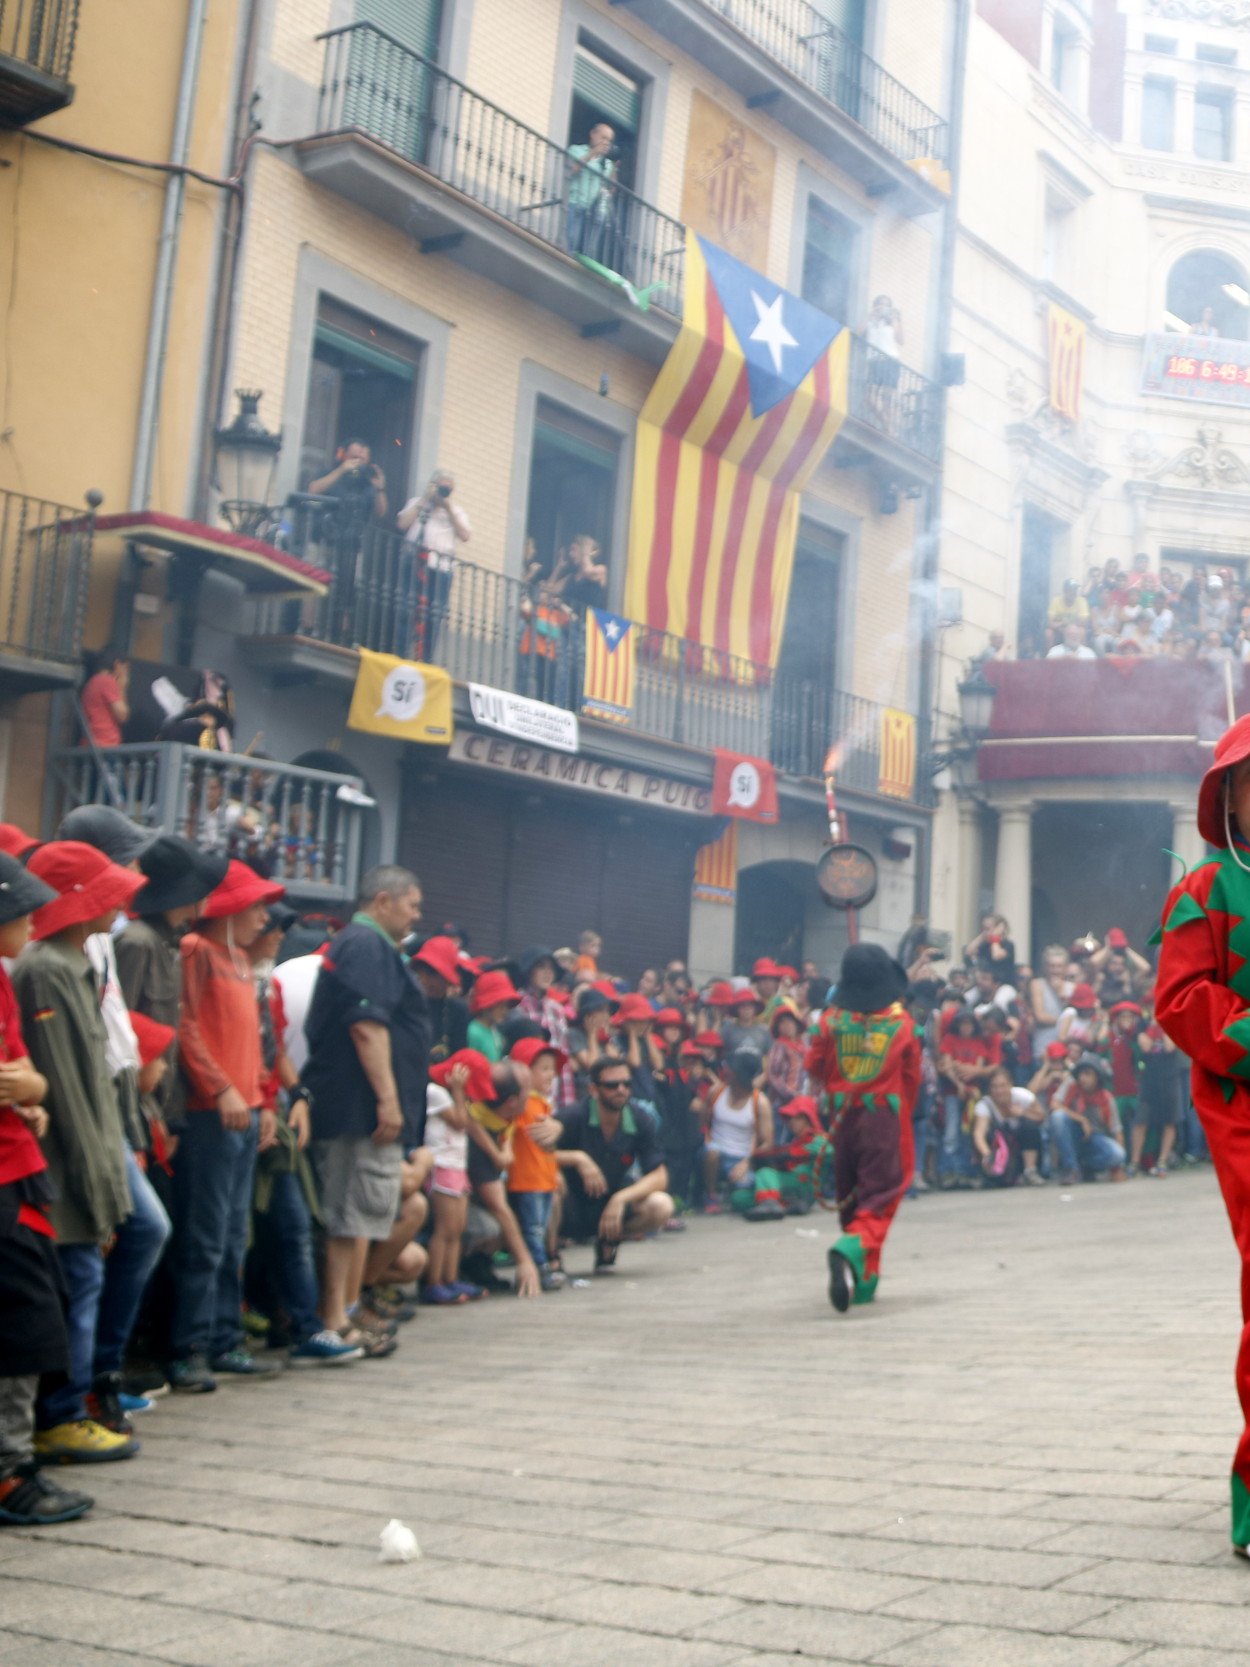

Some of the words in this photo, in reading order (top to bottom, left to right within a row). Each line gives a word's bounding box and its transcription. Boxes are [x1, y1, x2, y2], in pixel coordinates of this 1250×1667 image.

[392, 679, 416, 704] Sí
[463, 735, 629, 795] CERAMICA
[641, 777, 712, 810] PUIG
